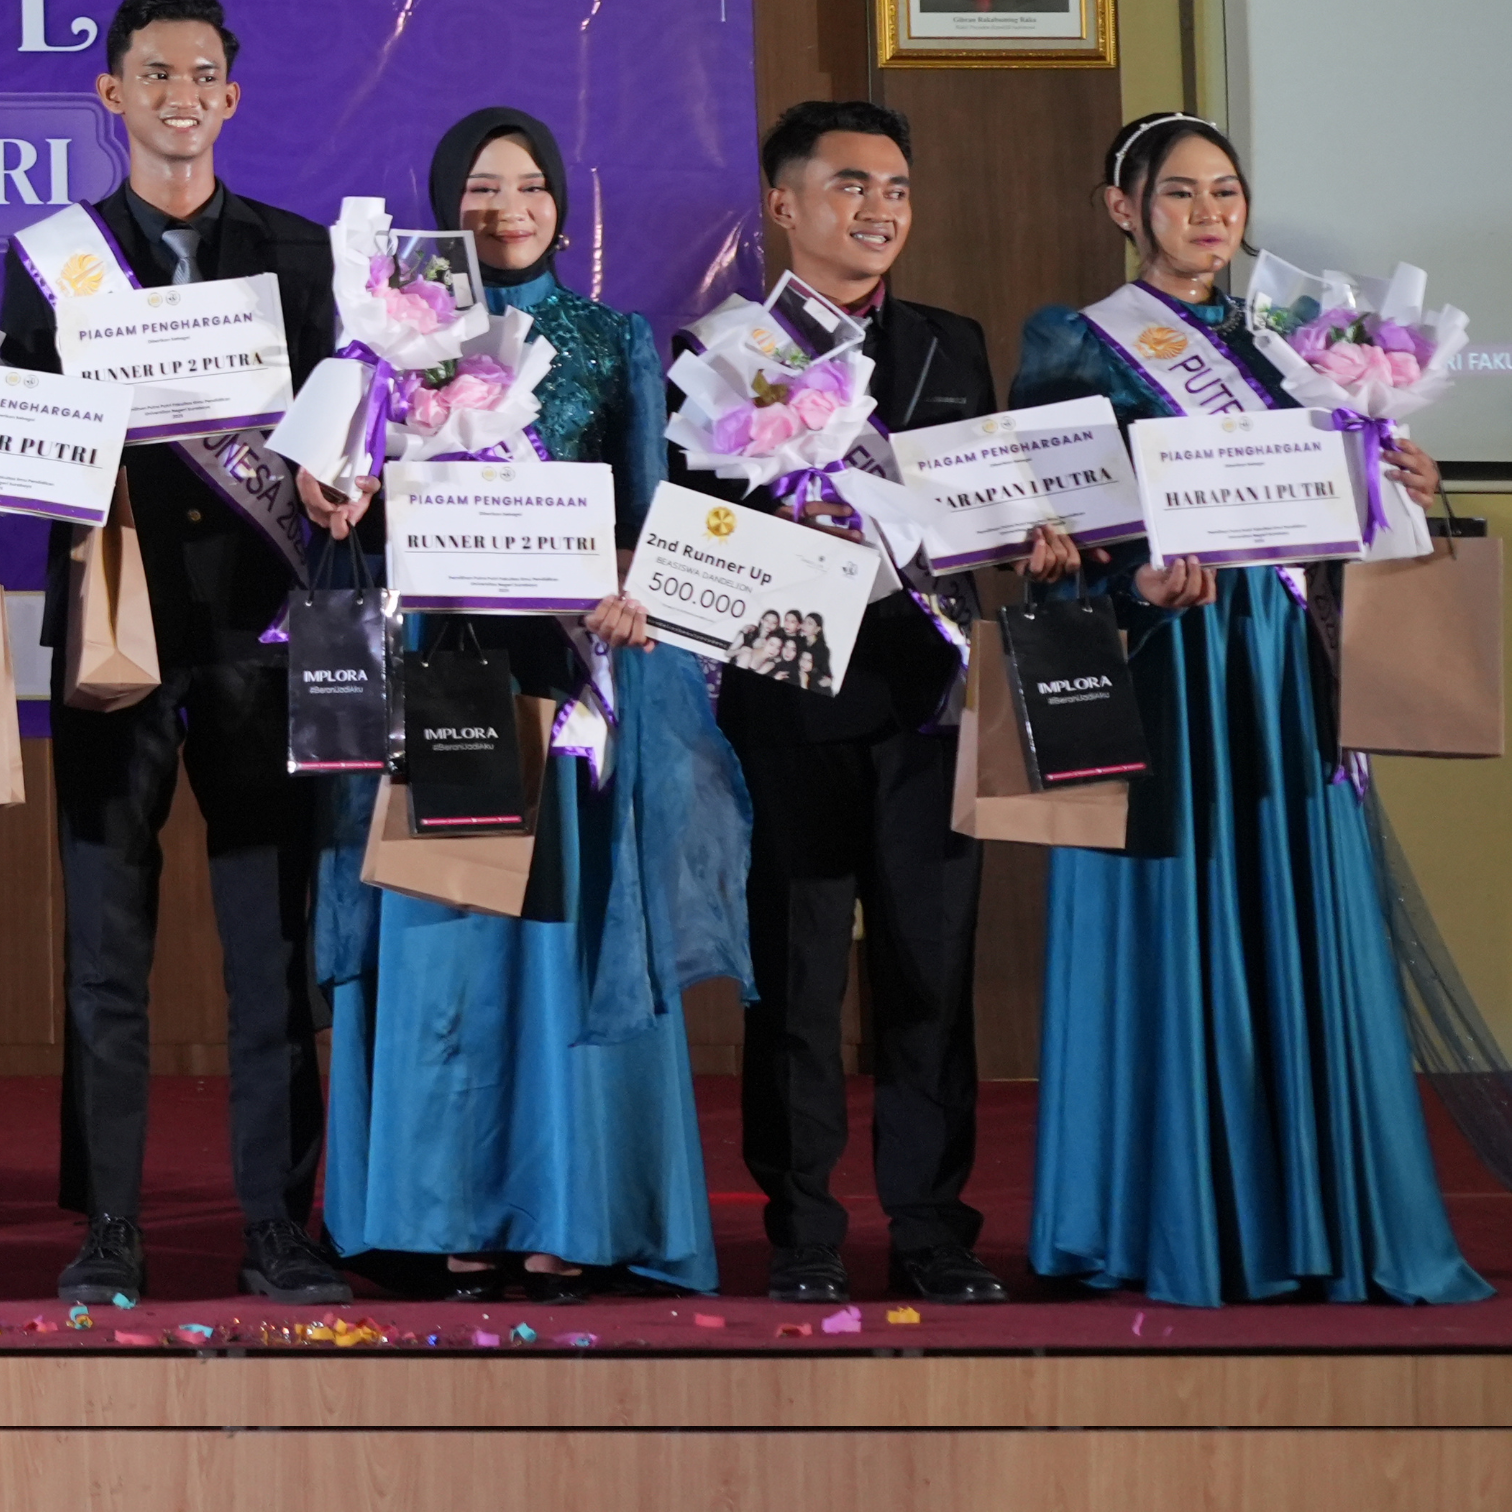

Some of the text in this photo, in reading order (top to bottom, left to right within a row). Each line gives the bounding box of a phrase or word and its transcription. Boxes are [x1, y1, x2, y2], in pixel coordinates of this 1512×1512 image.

[79, 313, 253, 340] PIAGAM PENGHARGAAN
[160, 361, 182, 374] UP
[188, 359, 198, 372] 2
[202, 351, 264, 370] PUTRA
[20, 438, 99, 465] PUTRI
[917, 431, 1094, 471] PIAGAM PENGHARGAAN
[1160, 442, 1322, 462] PIAGAM PENGHARGAAN
[1042, 467, 1113, 492] PUTRA
[409, 494, 588, 507] PIAGAM PENGHARGAAN
[1165, 487, 1259, 507] HARAPAN
[1276, 481, 1335, 499] PUTRI
[408, 534, 596, 551] RUNNER UP 2 PUTRI
[646, 533, 773, 585] 2nd Runner Up
[656, 556, 753, 594] BEASISWA DANDELION
[648, 571, 746, 619] 500.000
[303, 669, 368, 683] IMPLORA
[1037, 674, 1112, 696] IMPLORA
[424, 726, 498, 741] IMPLORA
